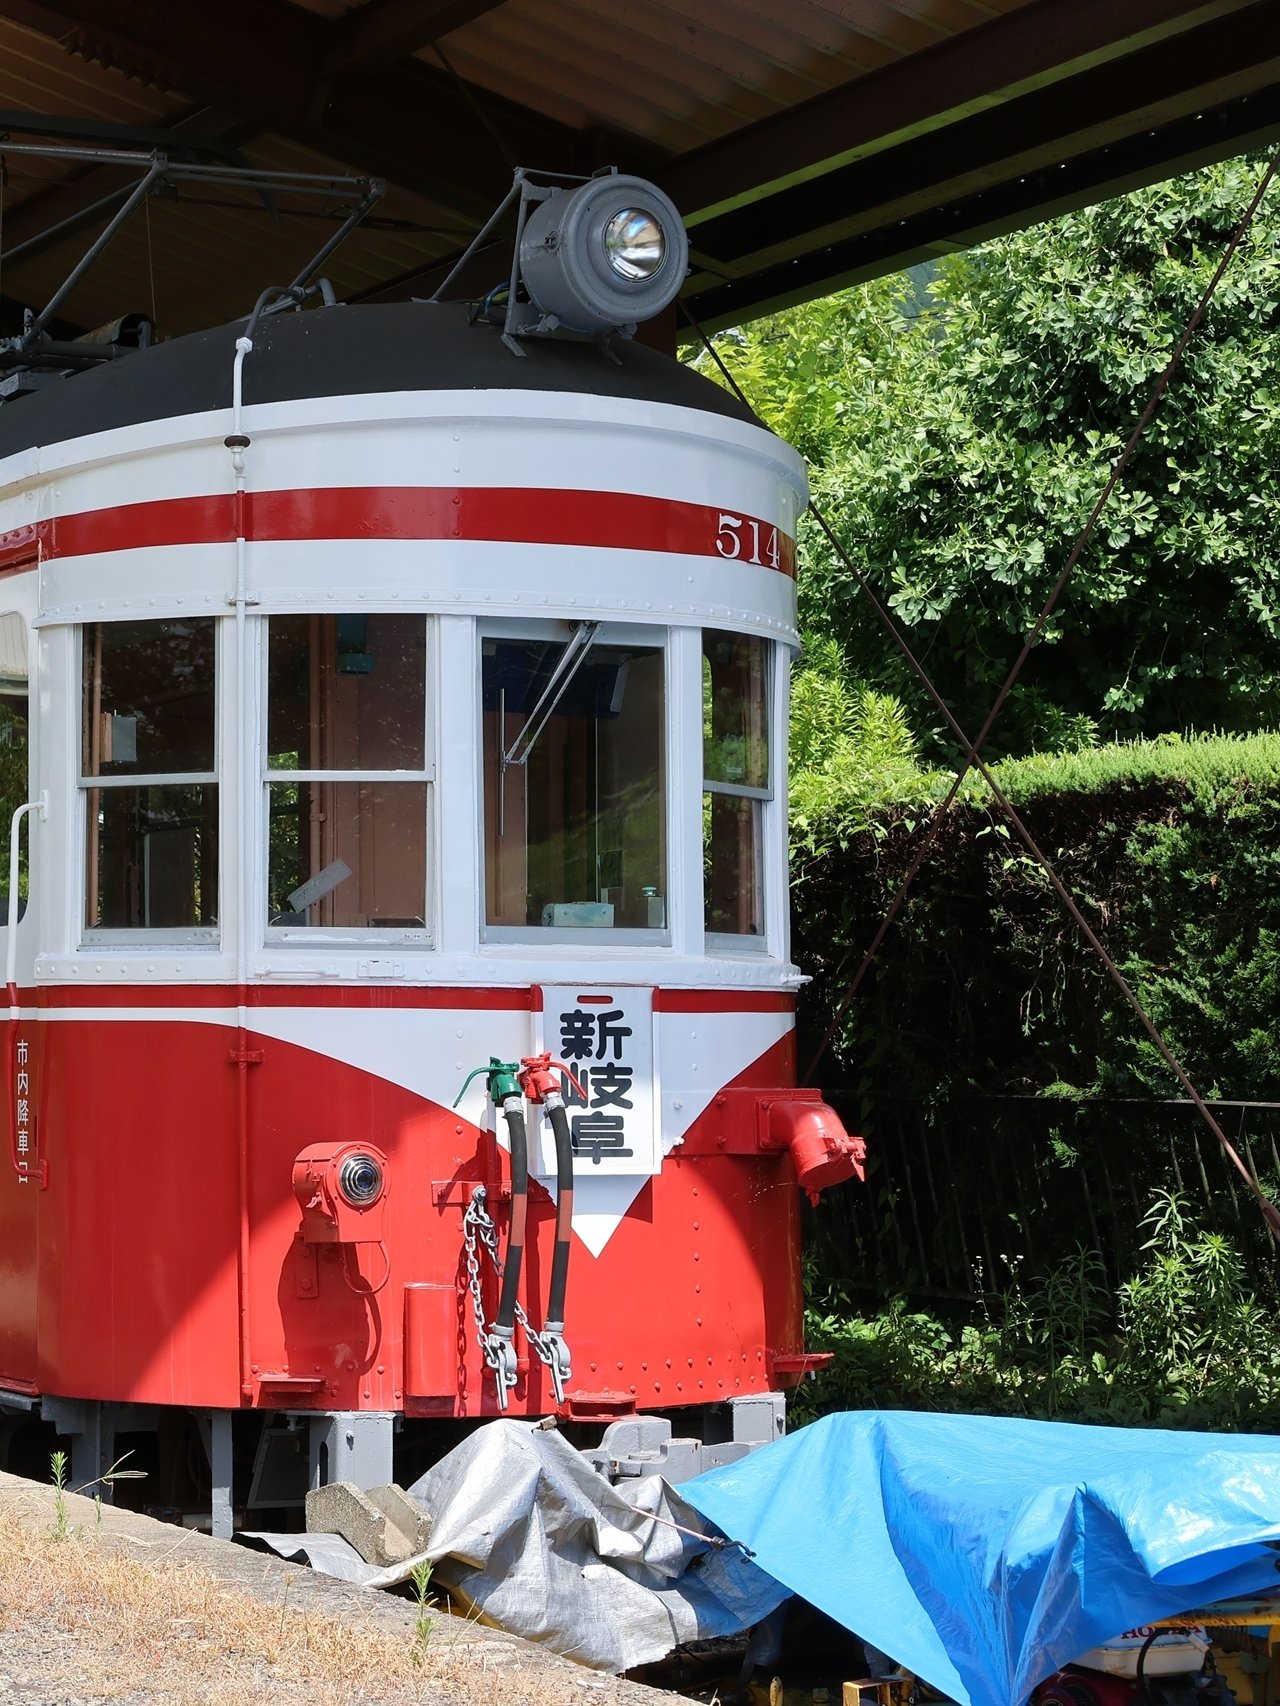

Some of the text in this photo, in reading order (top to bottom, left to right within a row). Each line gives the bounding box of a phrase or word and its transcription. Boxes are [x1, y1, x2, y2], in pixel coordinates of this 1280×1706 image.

[716, 512, 780, 569] 514
[559, 1008, 634, 1165] 新岐阜
